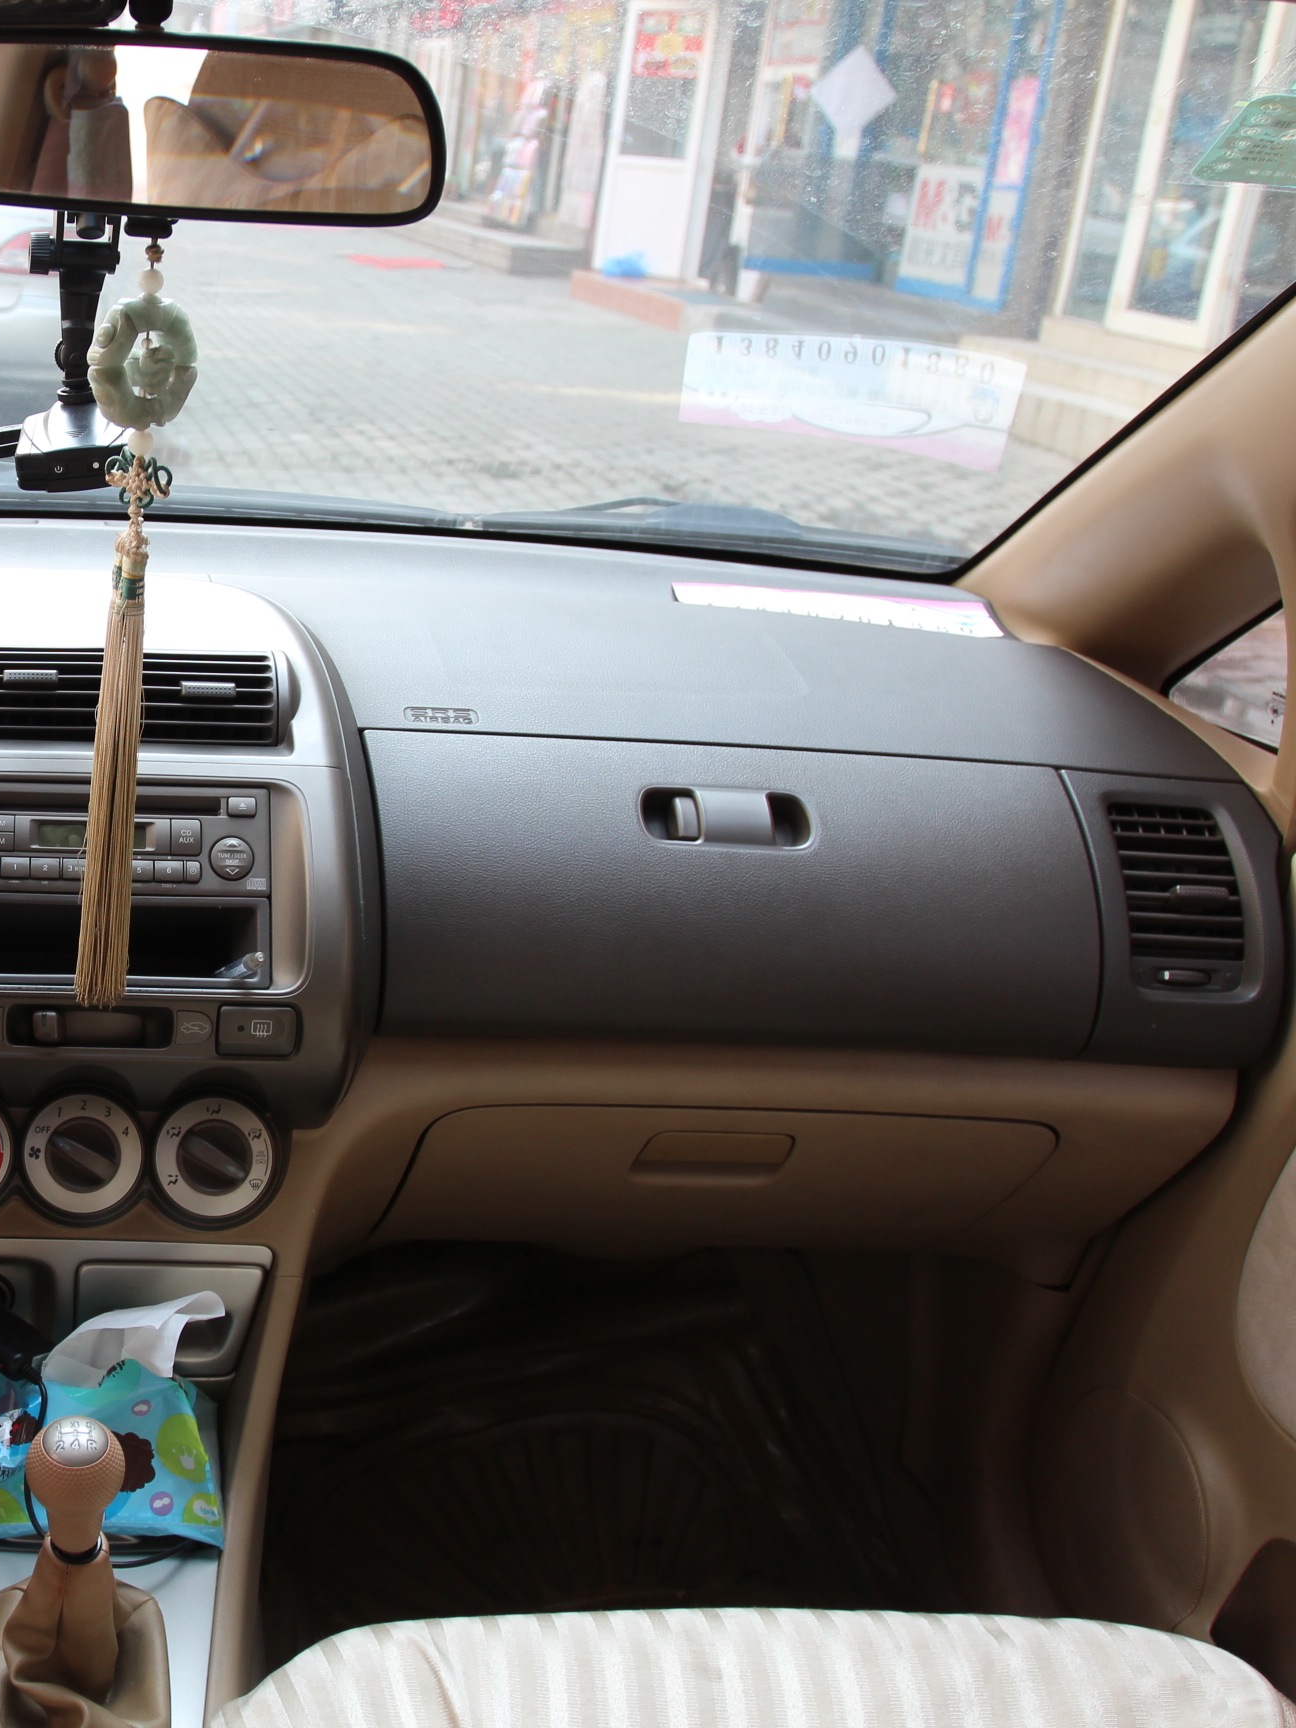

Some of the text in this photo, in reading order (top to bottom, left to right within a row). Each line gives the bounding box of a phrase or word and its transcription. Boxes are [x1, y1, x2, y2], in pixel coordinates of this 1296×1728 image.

[410, 708, 472, 718] SRS
[412, 716, 473, 725] AIRBAG
[180, 829, 192, 837] CD
[136, 866, 142, 874] 5
[80, 1100, 87, 1110] 2
[57, 1106, 62, 1118] 1
[104, 1106, 112, 1117] 3
[34, 1125, 51, 1134] OFF
[121, 1126, 129, 1137] 4
[55, 1438, 98, 1453] 2 4 R
